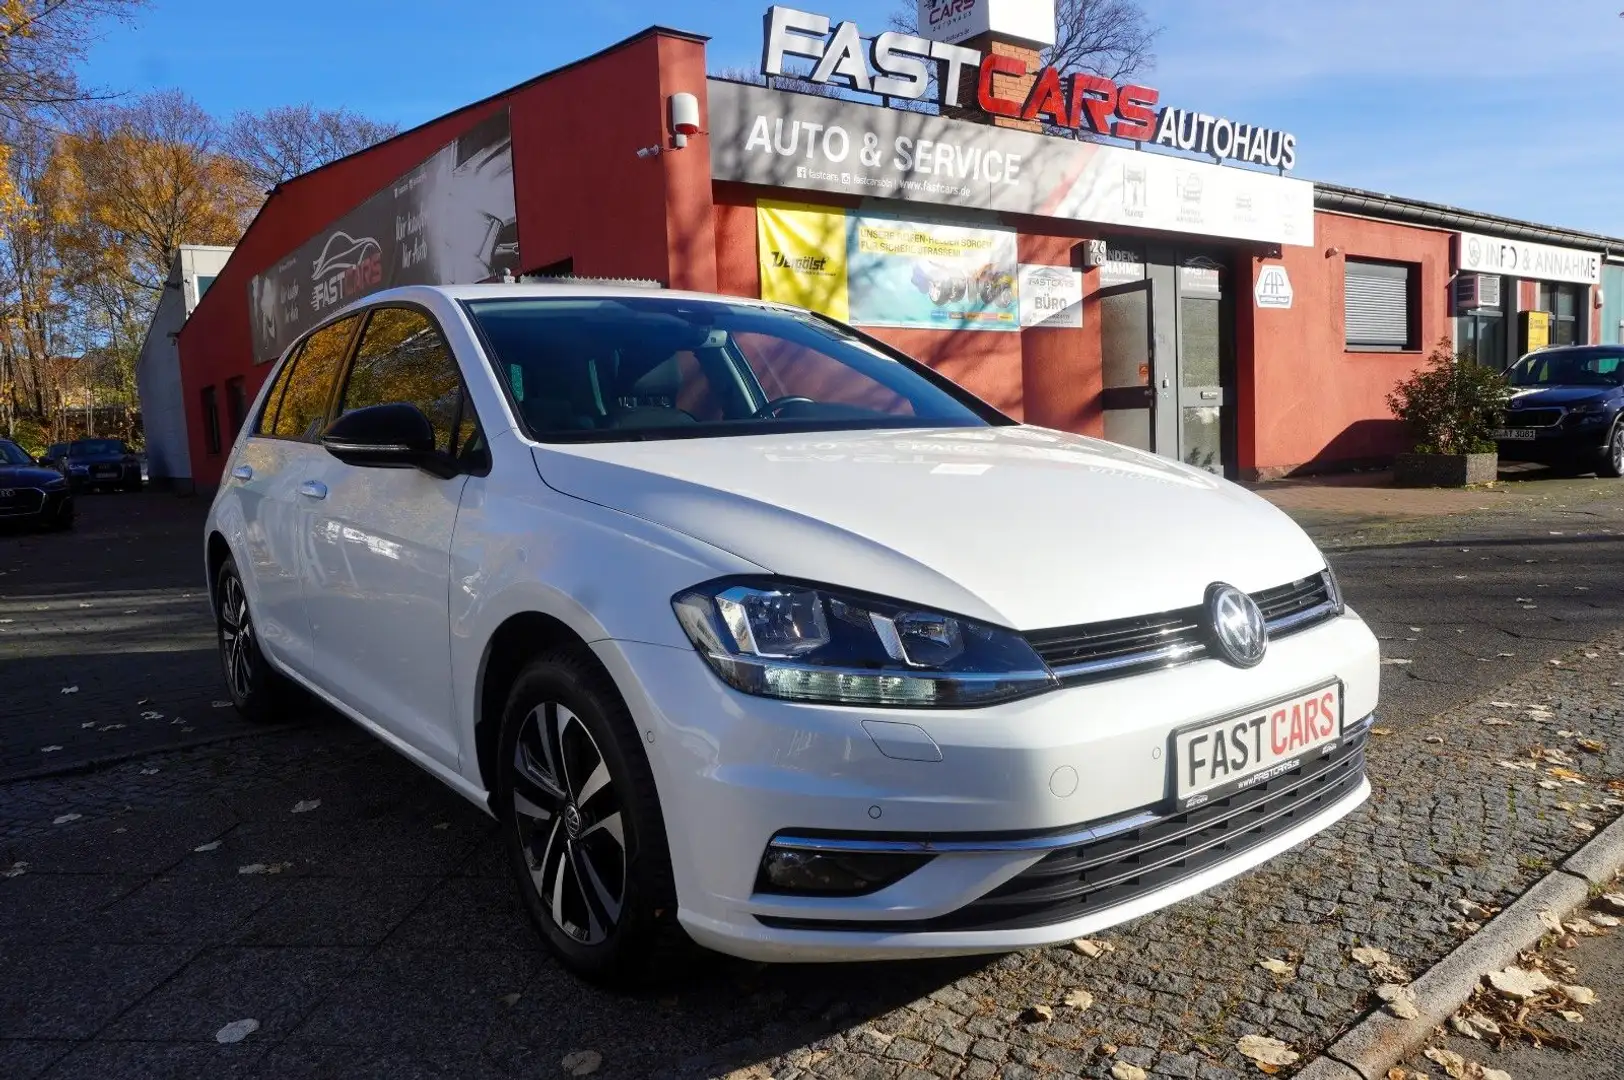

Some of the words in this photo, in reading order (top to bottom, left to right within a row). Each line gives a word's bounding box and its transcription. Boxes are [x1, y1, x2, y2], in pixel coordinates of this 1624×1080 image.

[929, 0, 975, 25] CARS
[745, 115, 849, 163] AUTO
[860, 131, 881, 167] &
[894, 136, 1021, 186] SERVICE
[1156, 106, 1296, 170] AUTOHAUS
[898, 179, 971, 198] www.fastcars.de
[1535, 250, 1596, 279] ANNAHME
[1035, 293, 1067, 310] BÜRO
